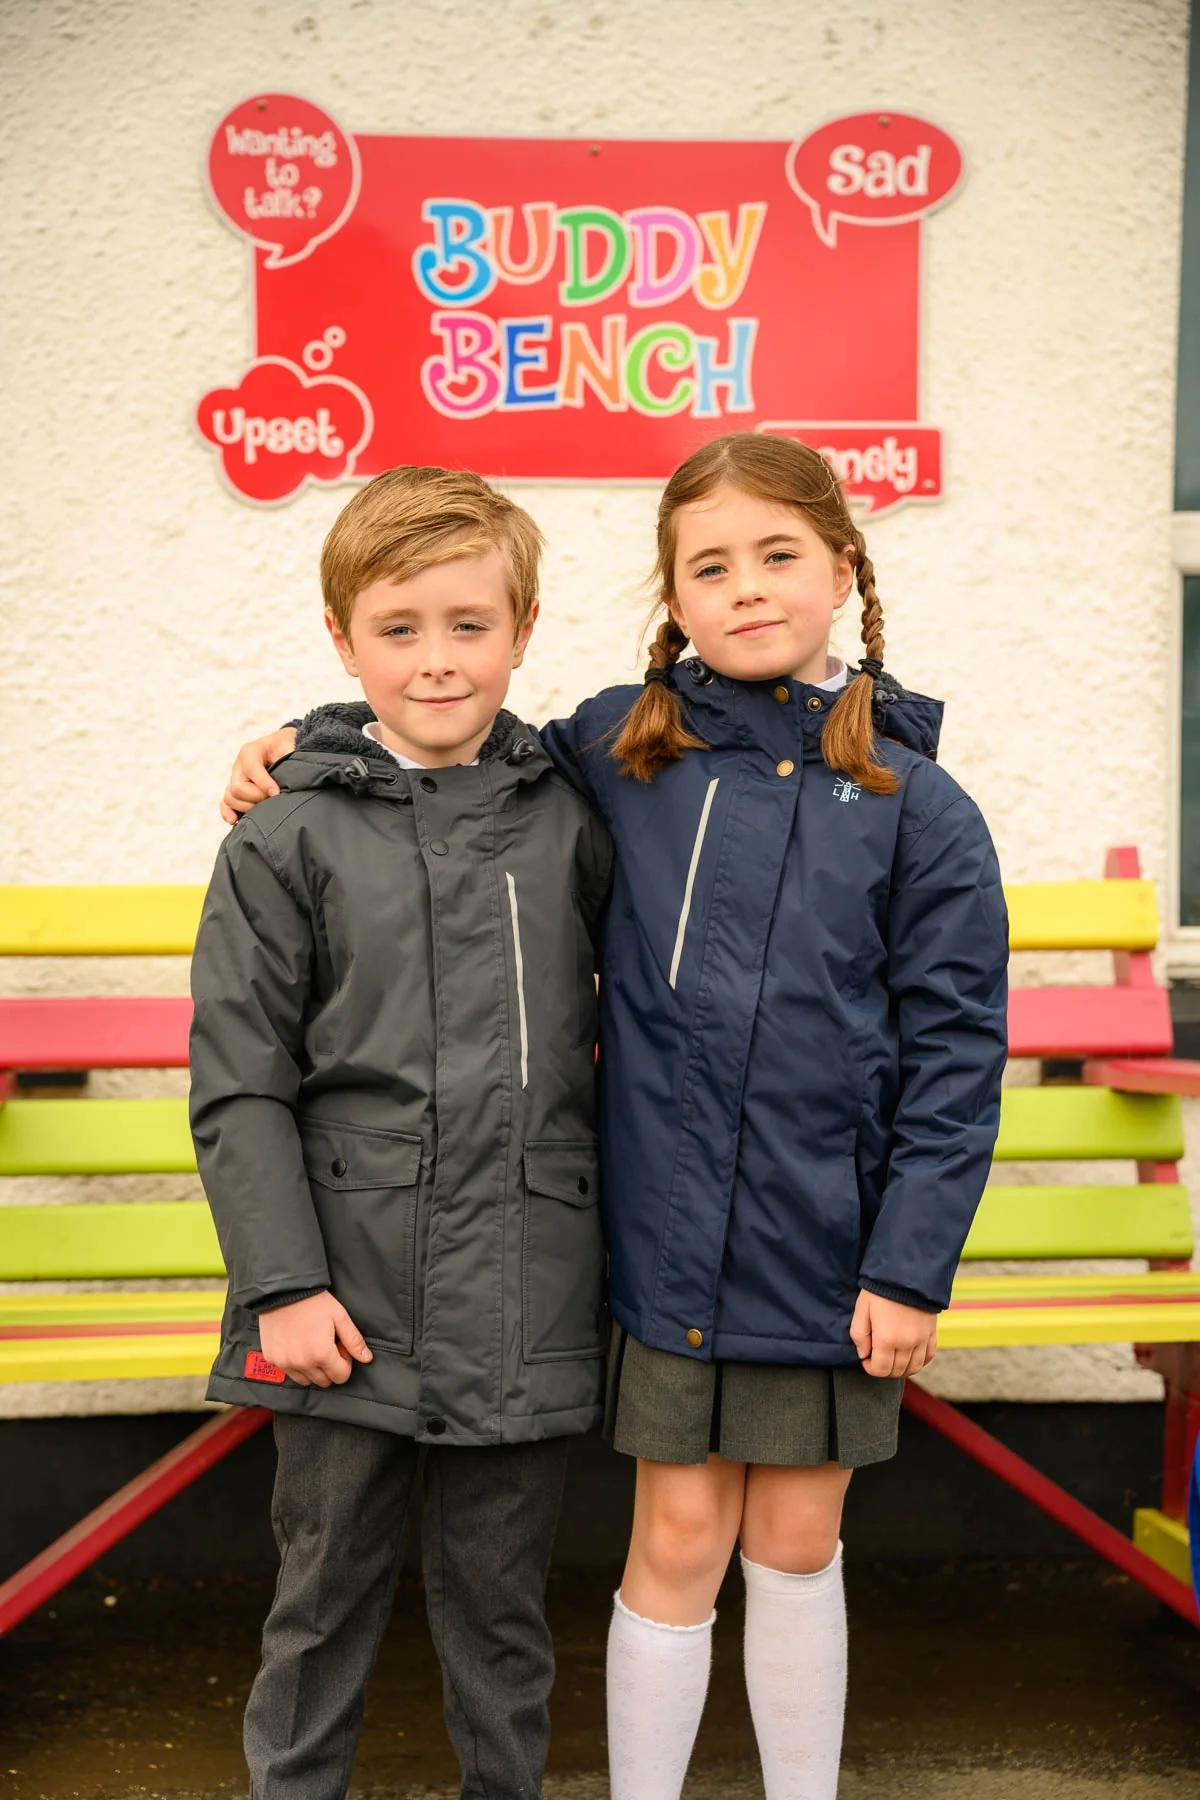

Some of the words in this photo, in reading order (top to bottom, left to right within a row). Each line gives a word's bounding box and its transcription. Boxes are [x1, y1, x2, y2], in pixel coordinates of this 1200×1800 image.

[265, 156, 300, 188] to
[827, 144, 932, 198] Sad
[244, 186, 323, 220] talk?
[412, 198, 767, 310] BUDDY
[421, 311, 759, 420] BENCH
[213, 407, 344, 464] Upset
[816, 436, 918, 493] onely
